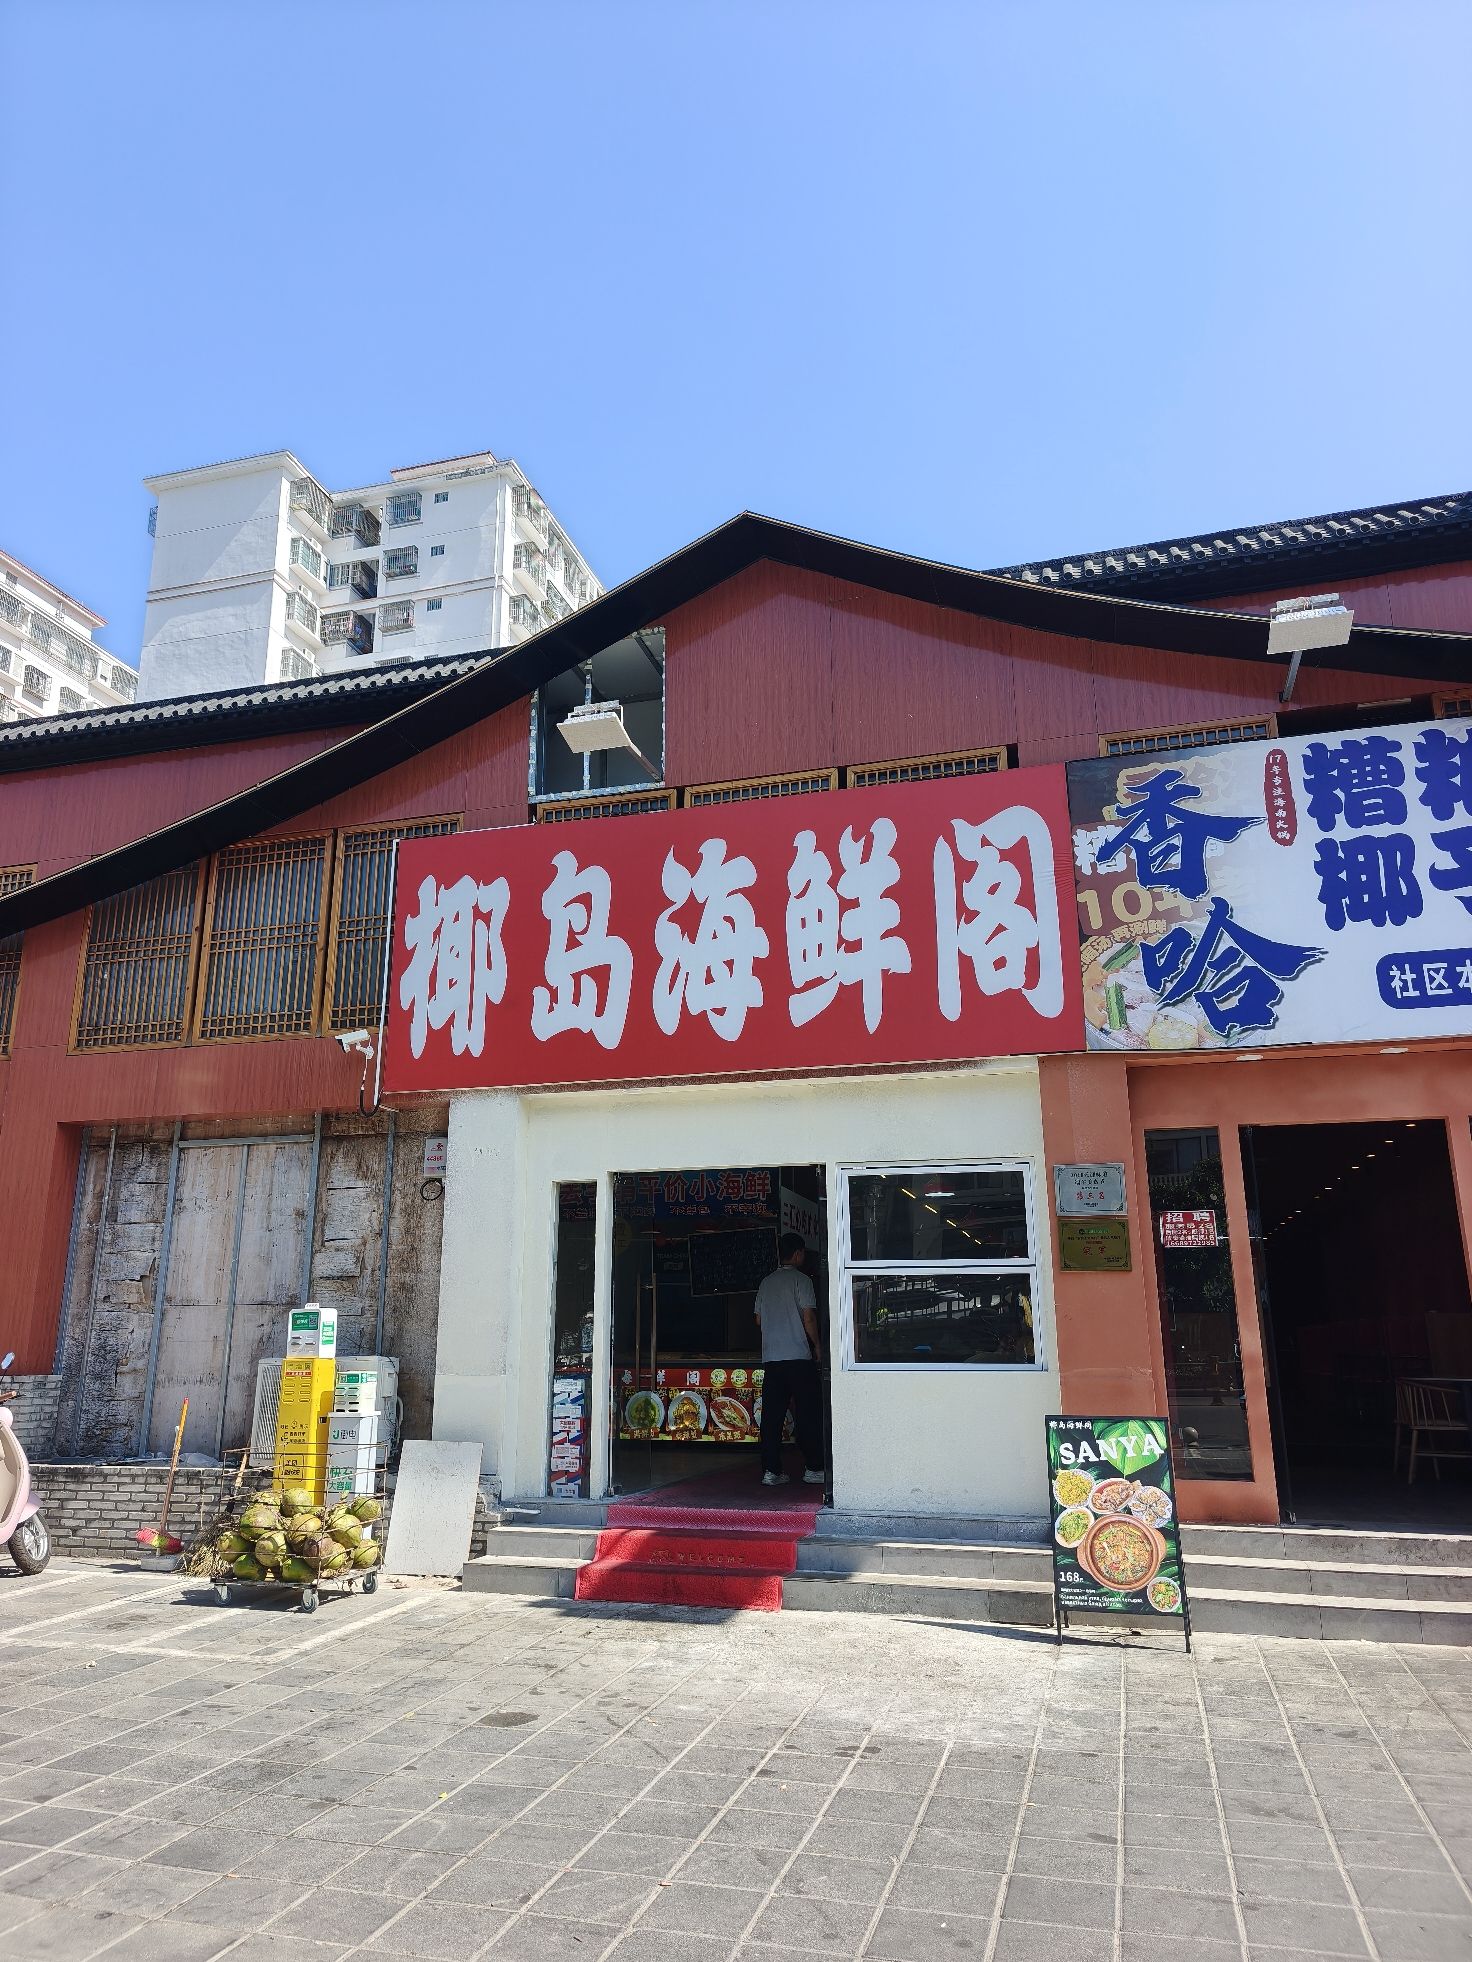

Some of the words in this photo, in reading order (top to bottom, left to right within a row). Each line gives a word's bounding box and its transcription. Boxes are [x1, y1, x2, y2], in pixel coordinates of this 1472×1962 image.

[401, 805, 1064, 1059] 椰岛海鲜阁
[1165, 1212, 1210, 1222] 招聘
[1059, 1434, 1164, 1465] SANYA
[678, 1553, 745, 1564] WELCOME
